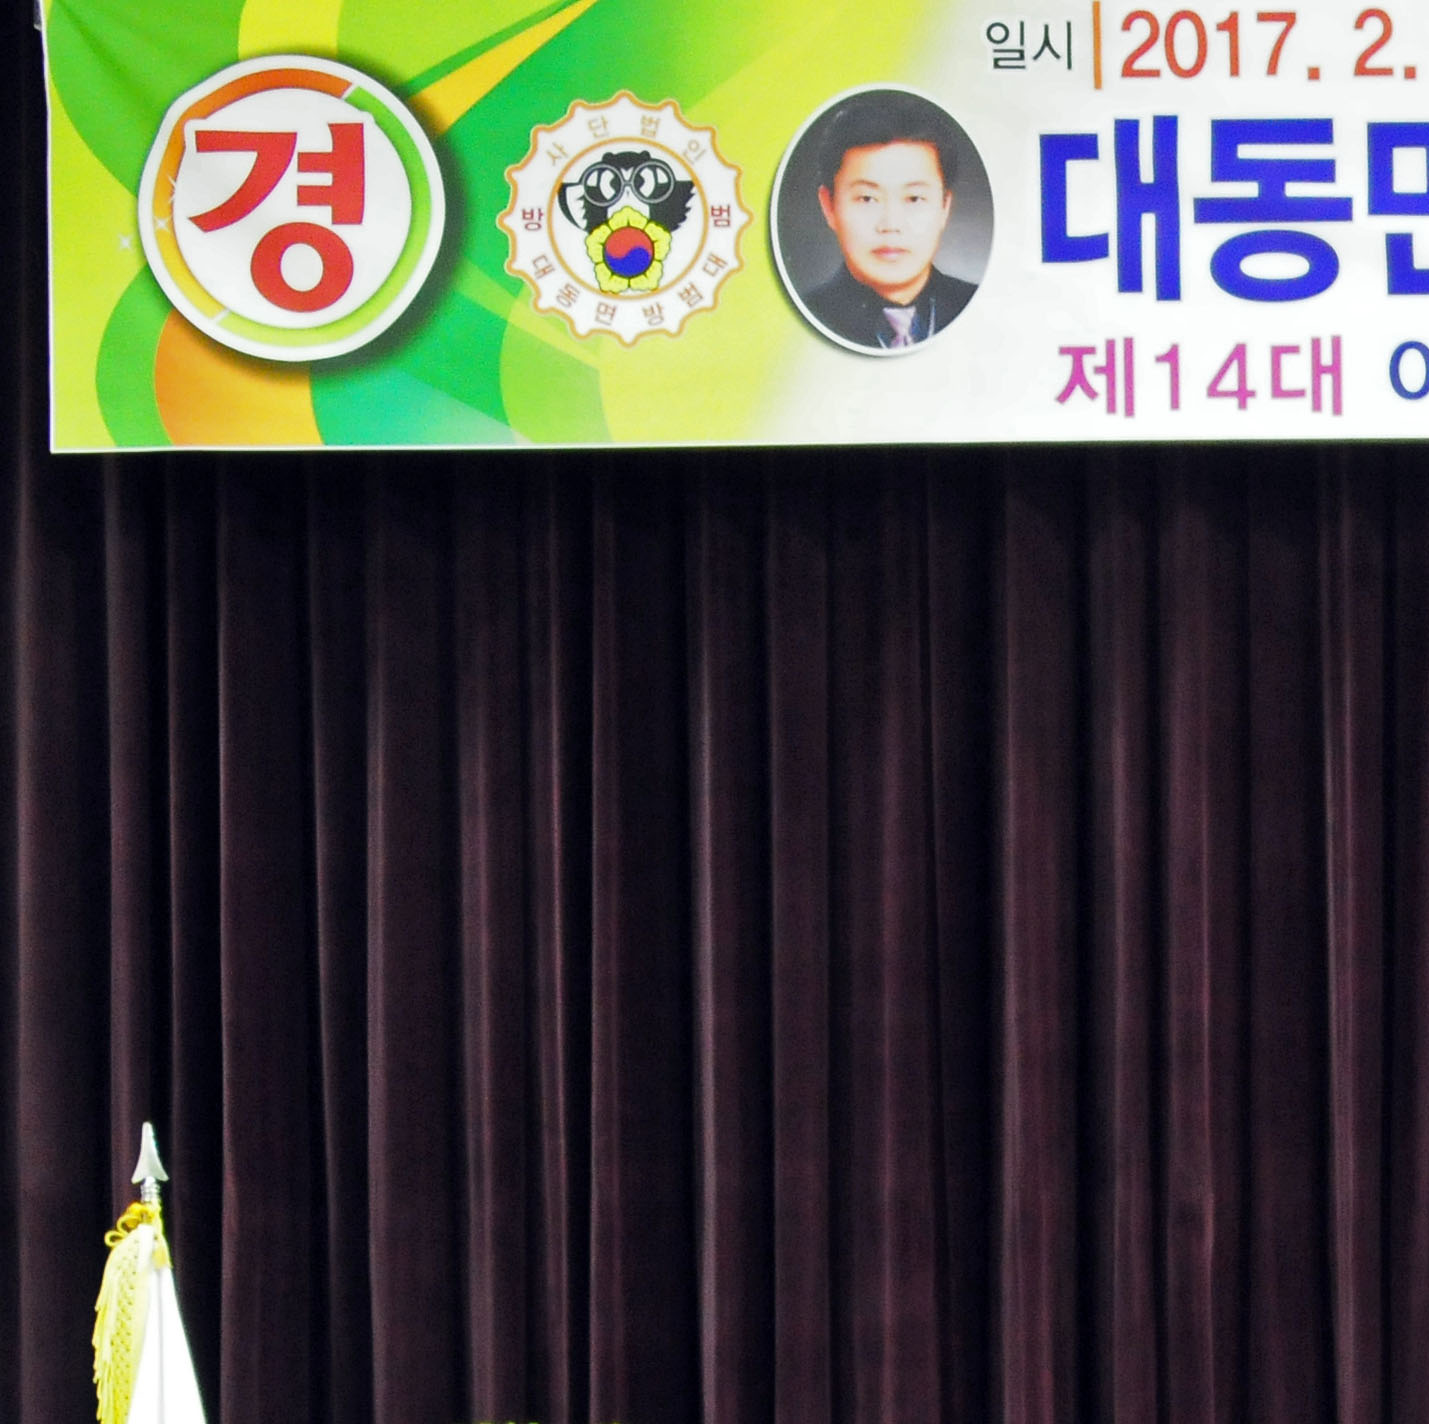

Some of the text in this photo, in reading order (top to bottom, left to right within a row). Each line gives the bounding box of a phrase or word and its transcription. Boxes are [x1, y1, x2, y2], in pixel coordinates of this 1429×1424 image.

[985, 19, 1073, 71] 일시
[1121, 10, 1320, 81] 2017.
[1352, 8, 1417, 80] 2.
[188, 121, 366, 313] 경
[521, 208, 544, 232] 방
[710, 205, 732, 229] 범
[1056, 334, 1344, 418] 제14대
